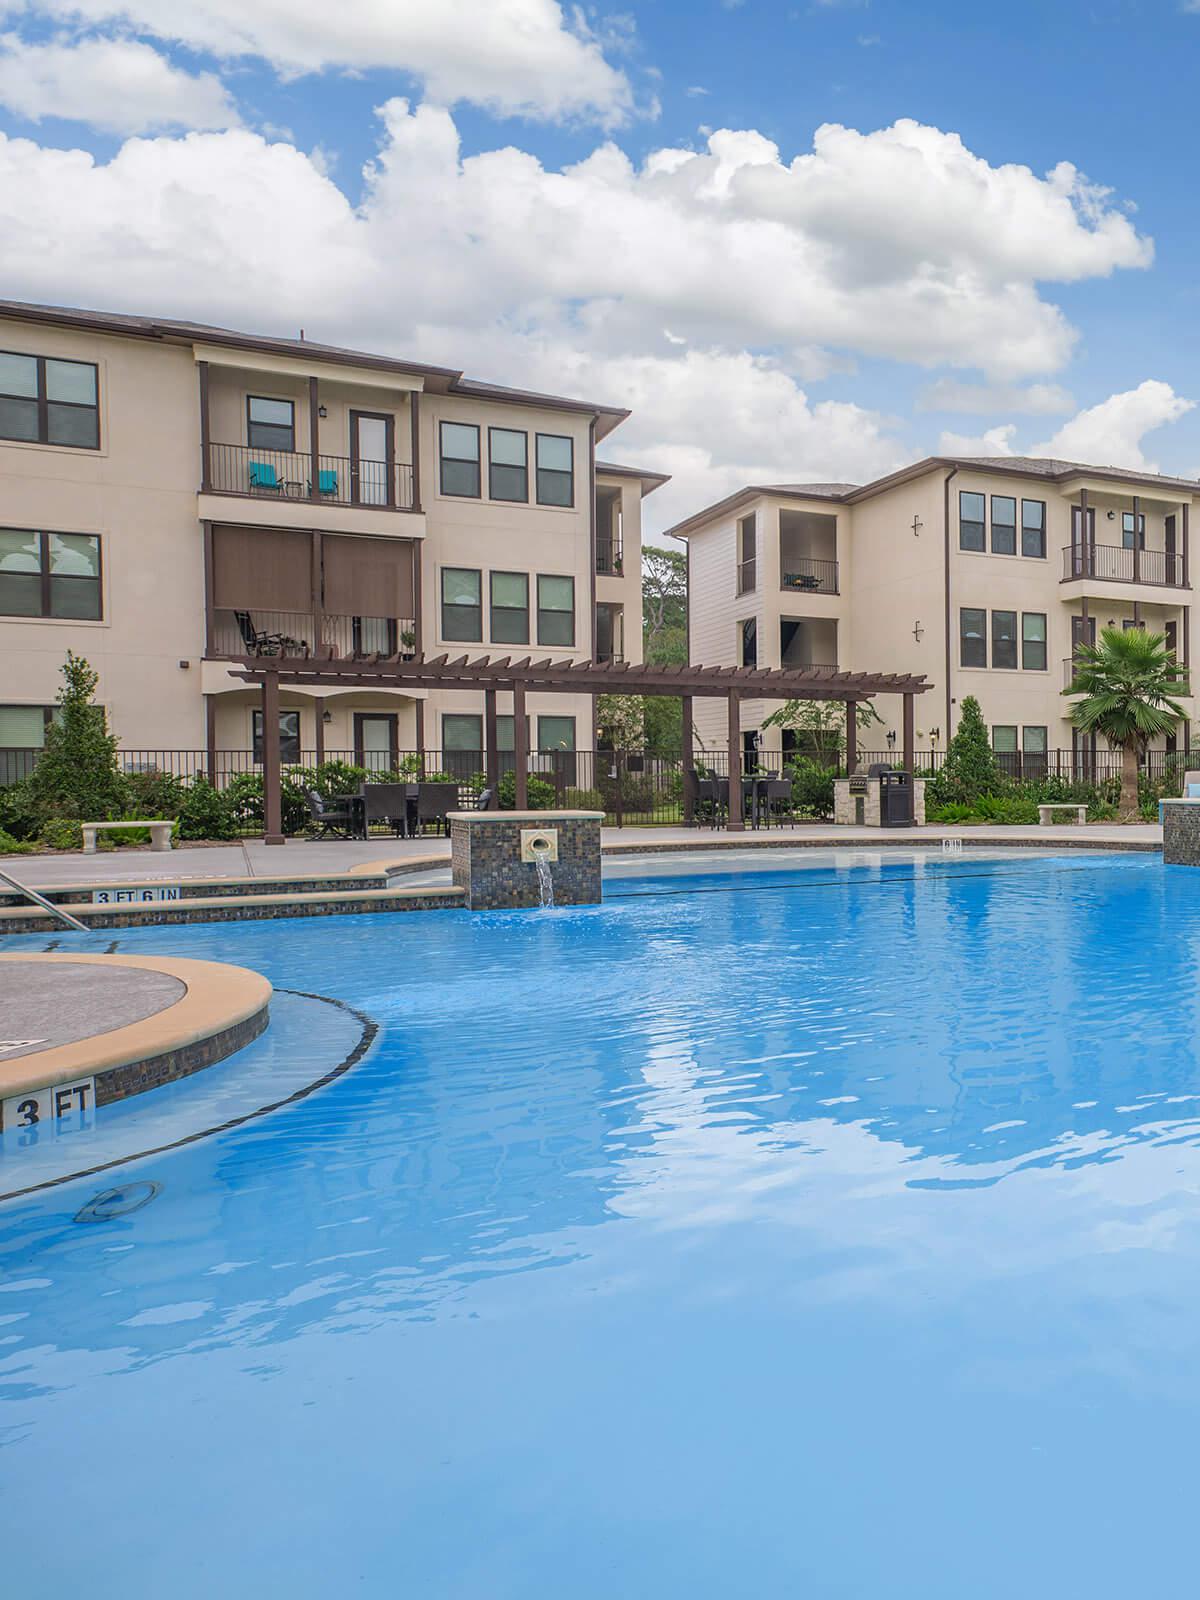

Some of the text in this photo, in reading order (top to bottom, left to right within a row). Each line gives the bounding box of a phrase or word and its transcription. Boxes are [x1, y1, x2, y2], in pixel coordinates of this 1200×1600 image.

[98, 889, 177, 903] 3 FT 6 IN
[17, 1083, 91, 1127] 3 FT
